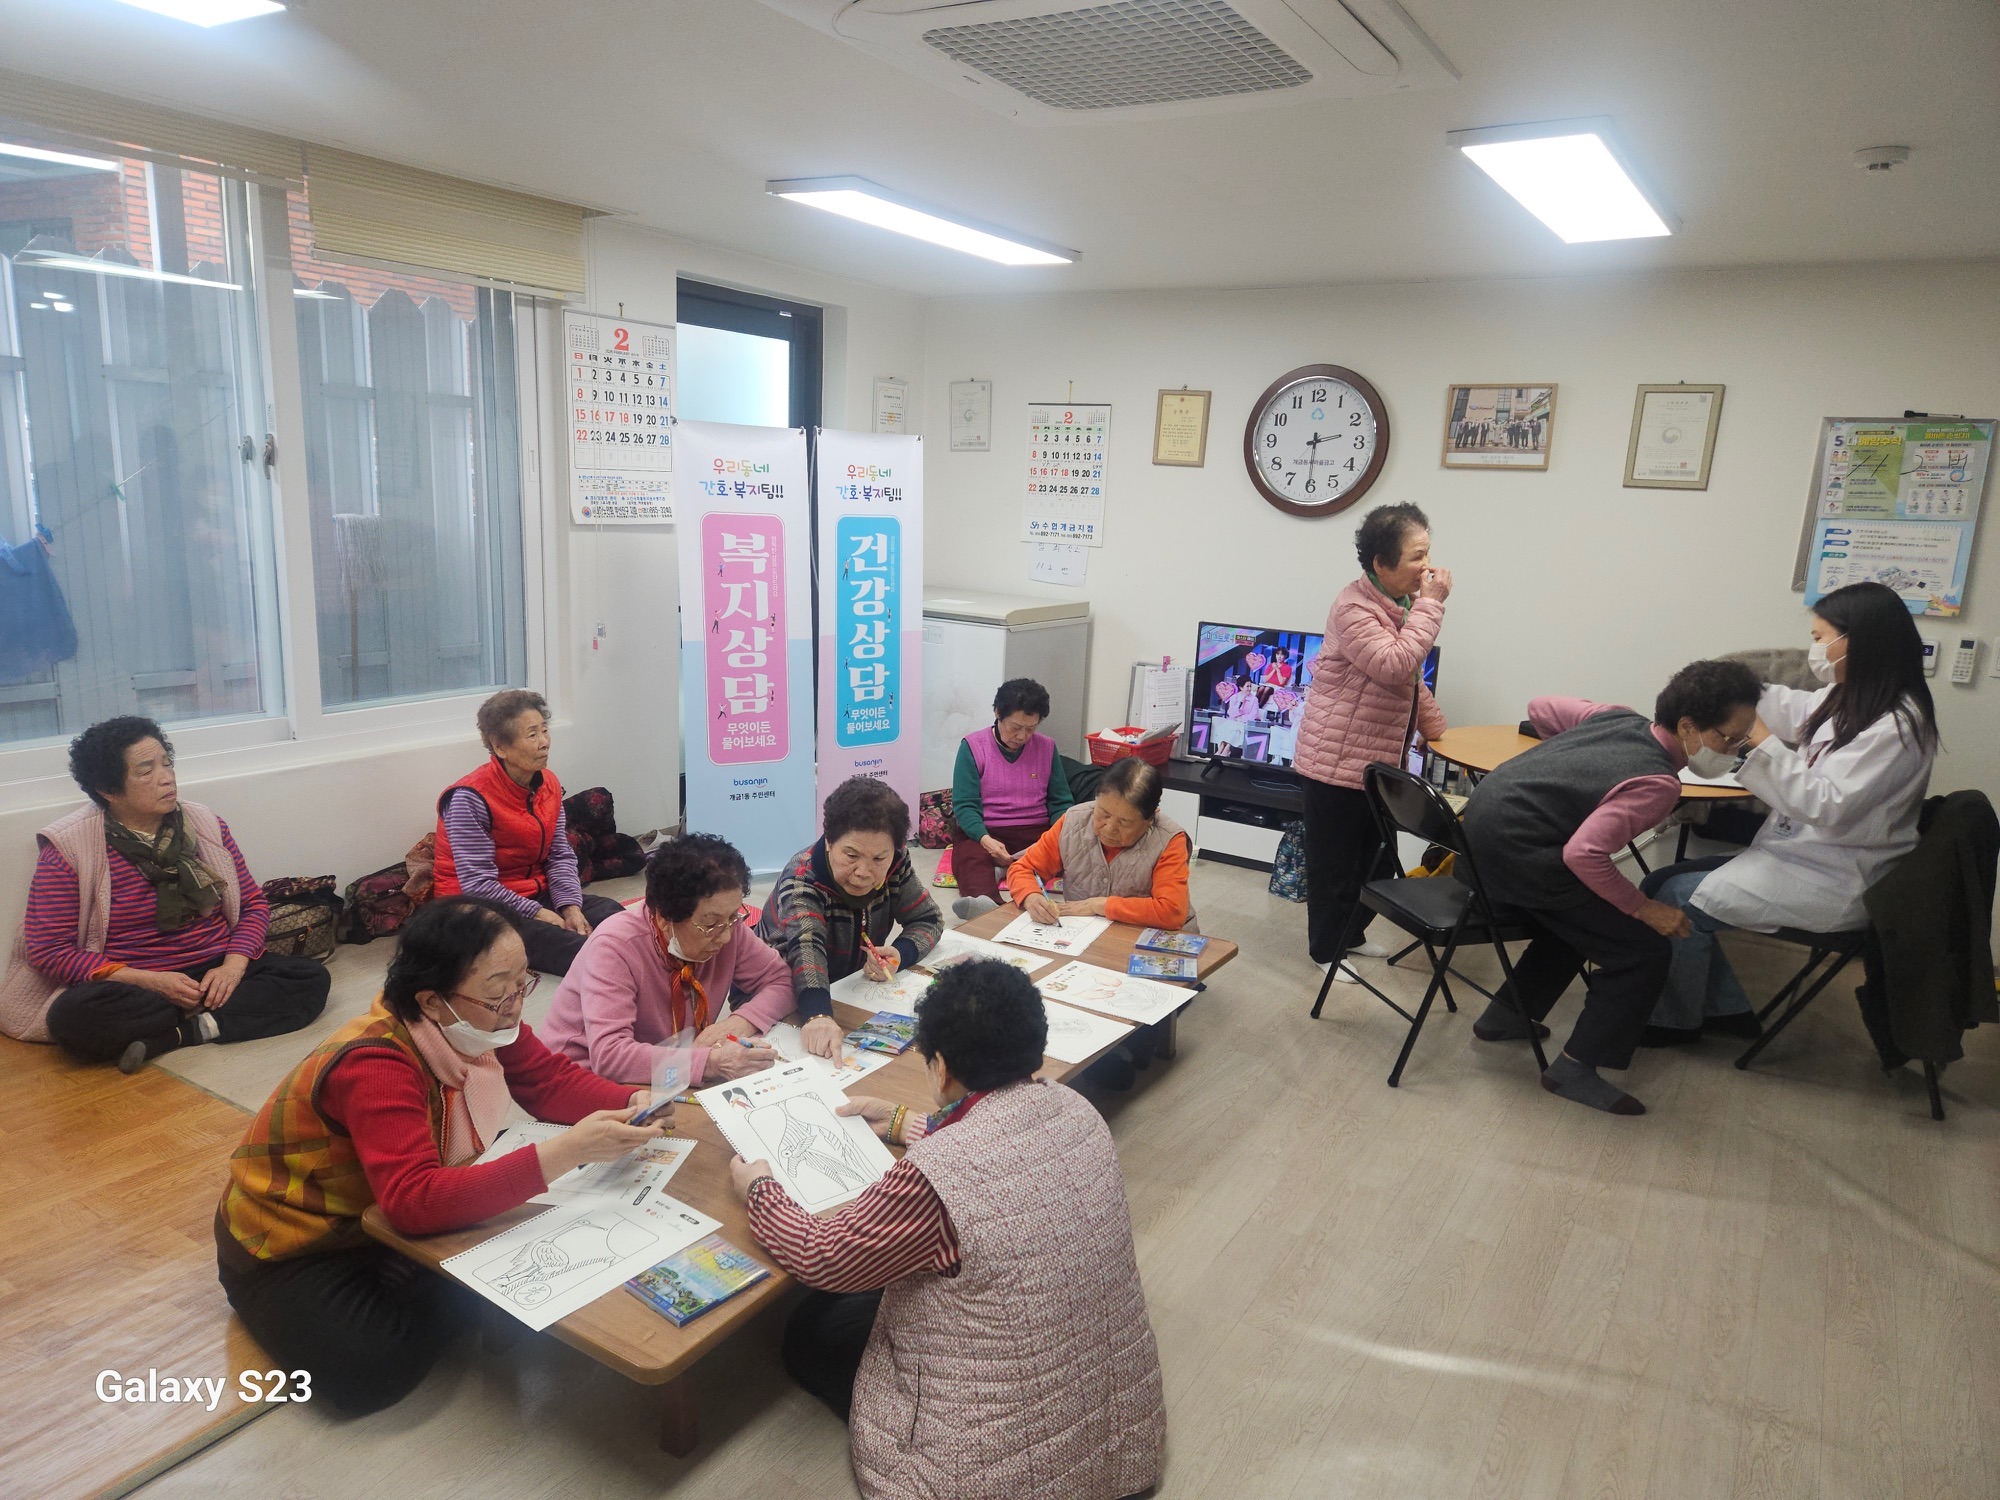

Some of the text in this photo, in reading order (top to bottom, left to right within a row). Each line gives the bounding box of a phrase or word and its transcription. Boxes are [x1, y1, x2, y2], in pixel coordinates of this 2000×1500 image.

[614, 328, 629, 351] 2
[578, 368, 665, 387] 1 2 3 4 5 6 7
[578, 388, 583, 398] 8
[605, 391, 614, 401] 10
[620, 393, 628, 403] 11
[633, 394, 642, 404] 12
[646, 395, 655, 405] 13
[659, 397, 668, 406] 14
[1292, 395, 1302, 409] 11
[1311, 389, 1327, 403] 12
[1338, 394, 1343, 408] 1
[576, 409, 586, 419] 15
[605, 412, 615, 422] 17
[620, 413, 629, 423] 18
[633, 414, 642, 424] 19
[646, 415, 656, 425] 20
[661, 416, 668, 426] 21
[1064, 412, 1073, 424] 2
[1274, 413, 1287, 427] 10
[1350, 412, 1361, 426] 2
[577, 430, 587, 440] 22
[605, 431, 615, 442] 24
[620, 433, 630, 442] 25
[633, 434, 643, 443] 26
[647, 435, 656, 444] 27
[660, 435, 669, 445] 28
[1044, 434, 1048, 442] 2
[1267, 433, 1277, 448] 9
[1353, 435, 1365, 449] 3
[712, 458, 770, 476] 우리동네
[1271, 457, 1282, 470] 8
[1343, 457, 1355, 471] 4
[846, 464, 892, 480] 우리동네
[1093, 470, 1100, 478] 21
[1285, 472, 1296, 485] 7
[1305, 479, 1316, 493] 6
[1327, 474, 1339, 488] 5
[1049, 485, 1057, 493] 24
[1070, 486, 1078, 494] 26
[1091, 487, 1099, 495] 28
[718, 532, 775, 716] 복지상담
[849, 533, 891, 703] 건강상담
[851, 706, 886, 720] 무엇이든
[727, 720, 771, 735] 무엇이든
[846, 719, 890, 735] 물어보세요
[721, 734, 777, 750] 물어보세요
[854, 759, 883, 768] busanjin
[733, 778, 768, 788] busanjin
[729, 790, 776, 801] 개금1동 주민센터
